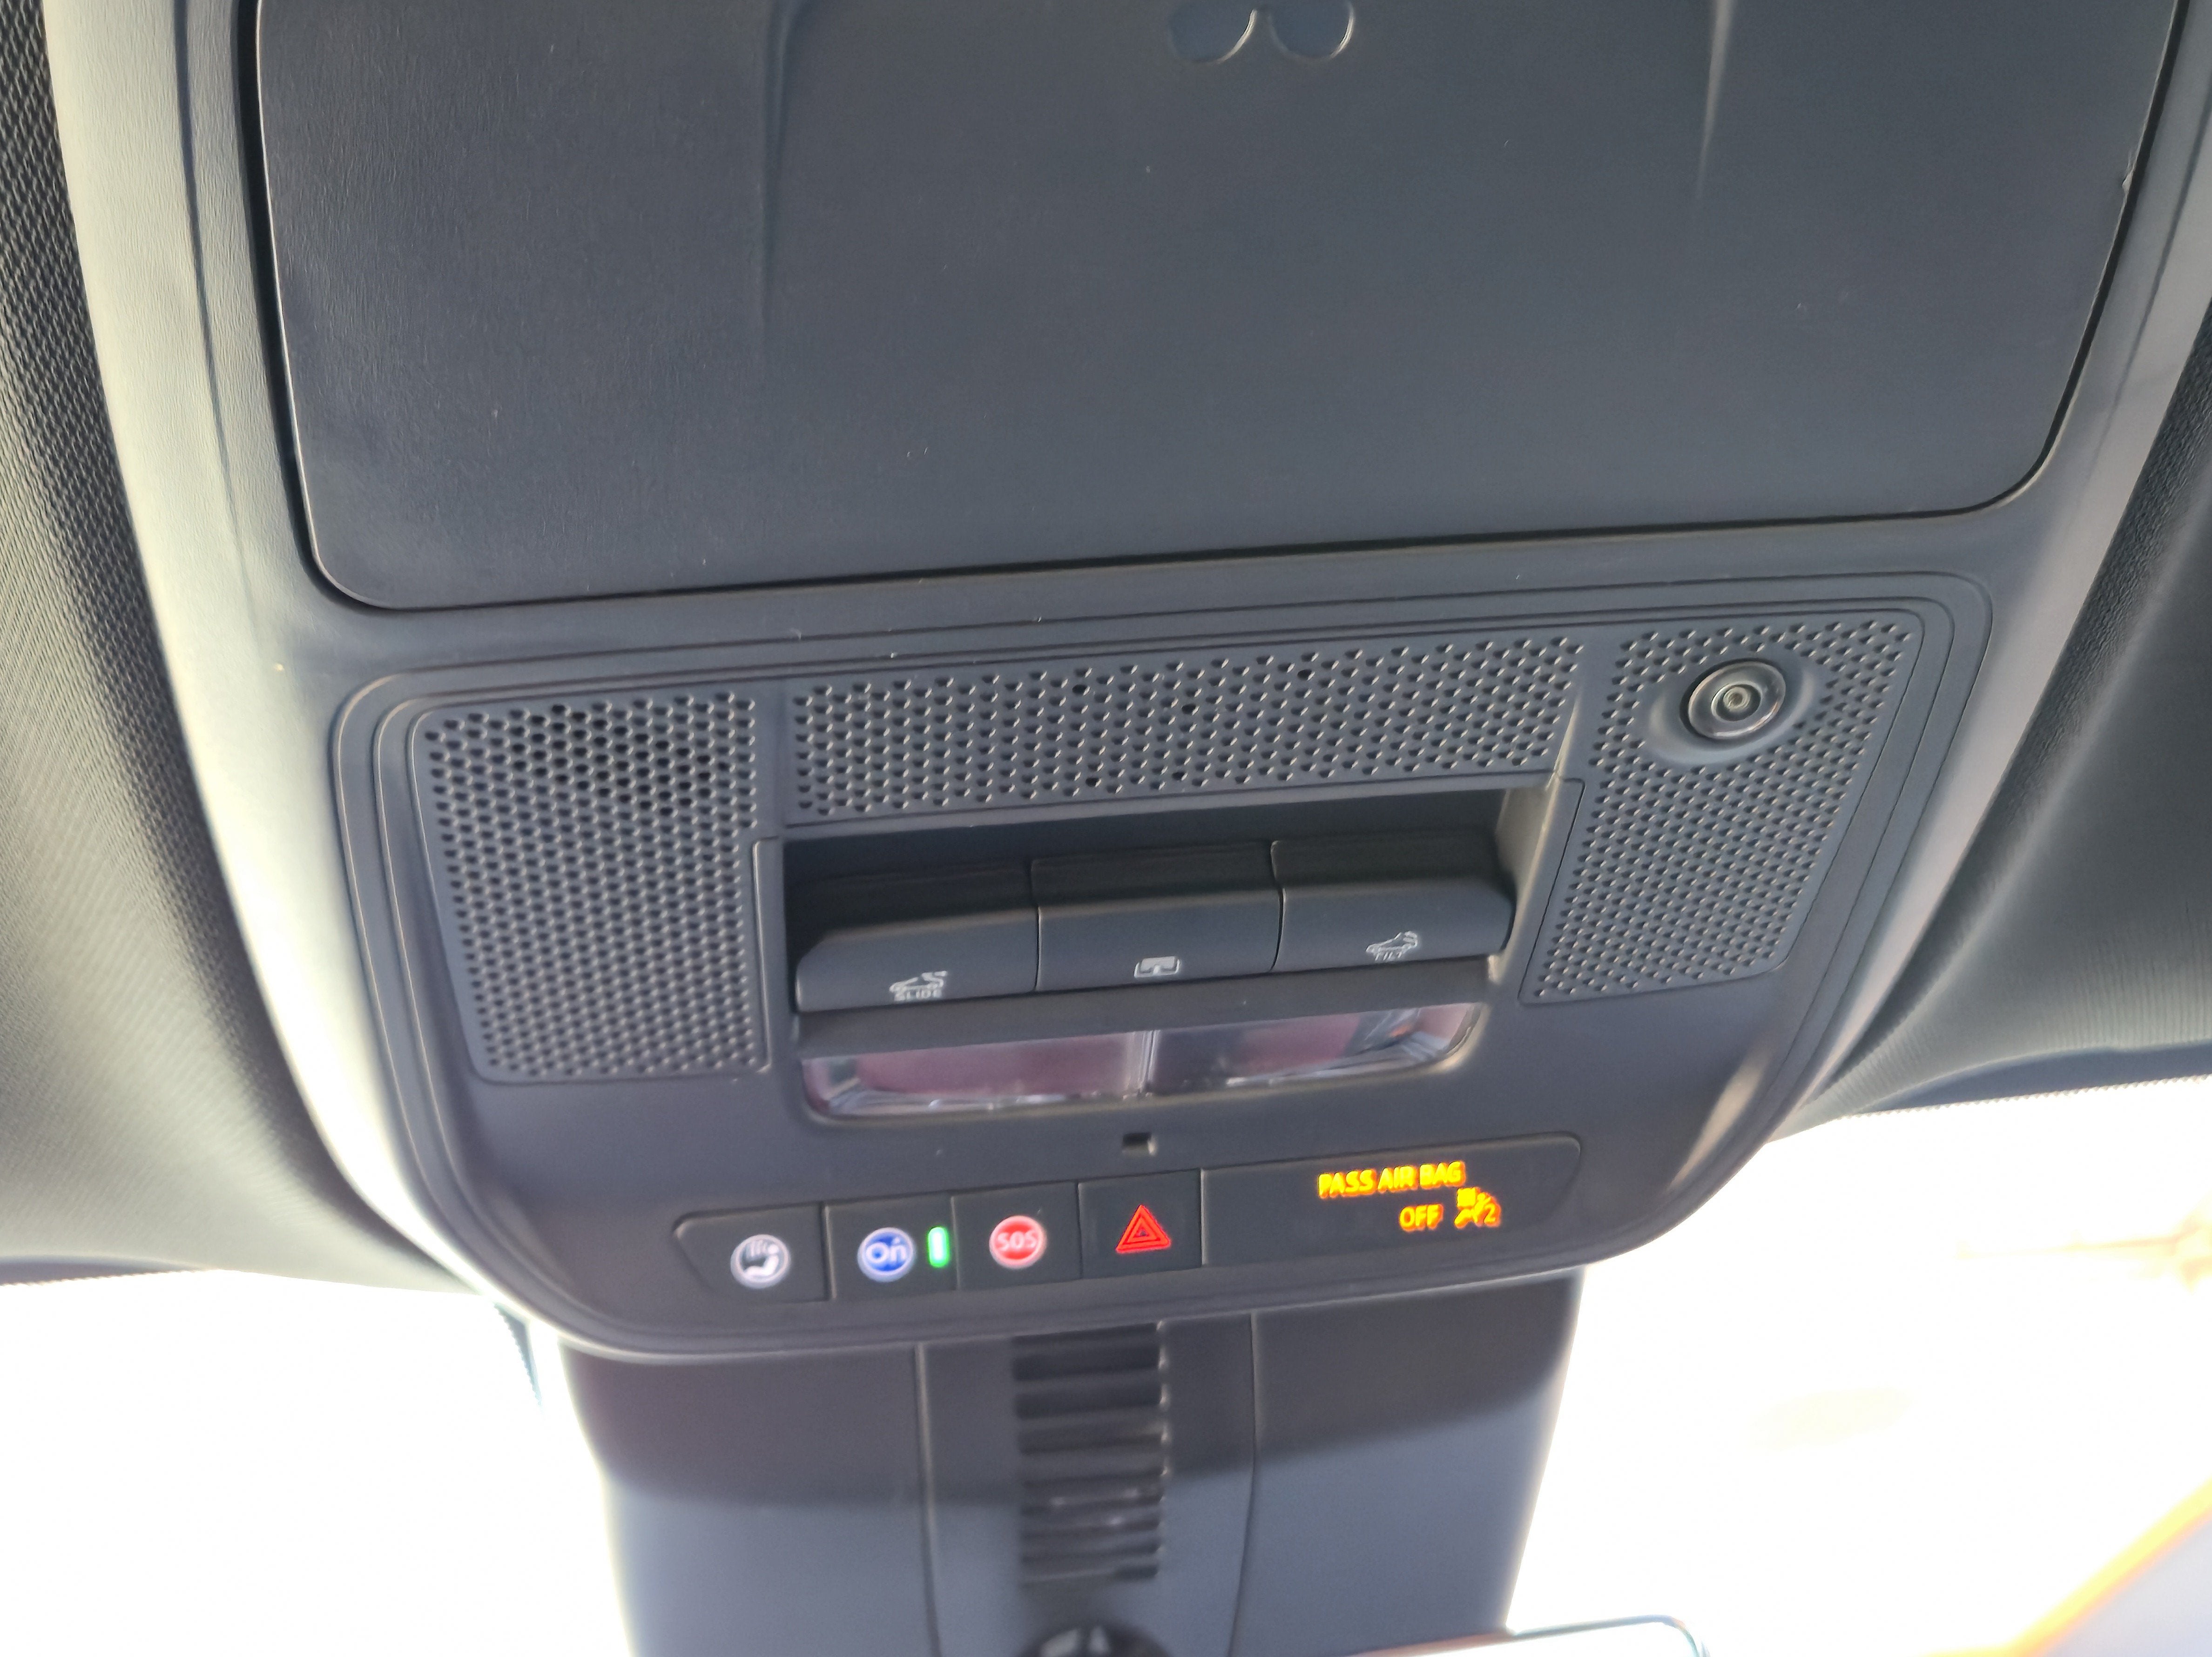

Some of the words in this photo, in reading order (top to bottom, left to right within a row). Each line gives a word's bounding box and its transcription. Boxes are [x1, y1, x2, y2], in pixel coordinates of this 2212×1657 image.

[1319, 1169, 1376, 1199] PASS
[1377, 1166, 1417, 1193] AIR
[1420, 1160, 1466, 1189] BAG
[1399, 1204, 1443, 1232] OFF
[997, 1230, 1038, 1252] SOS
